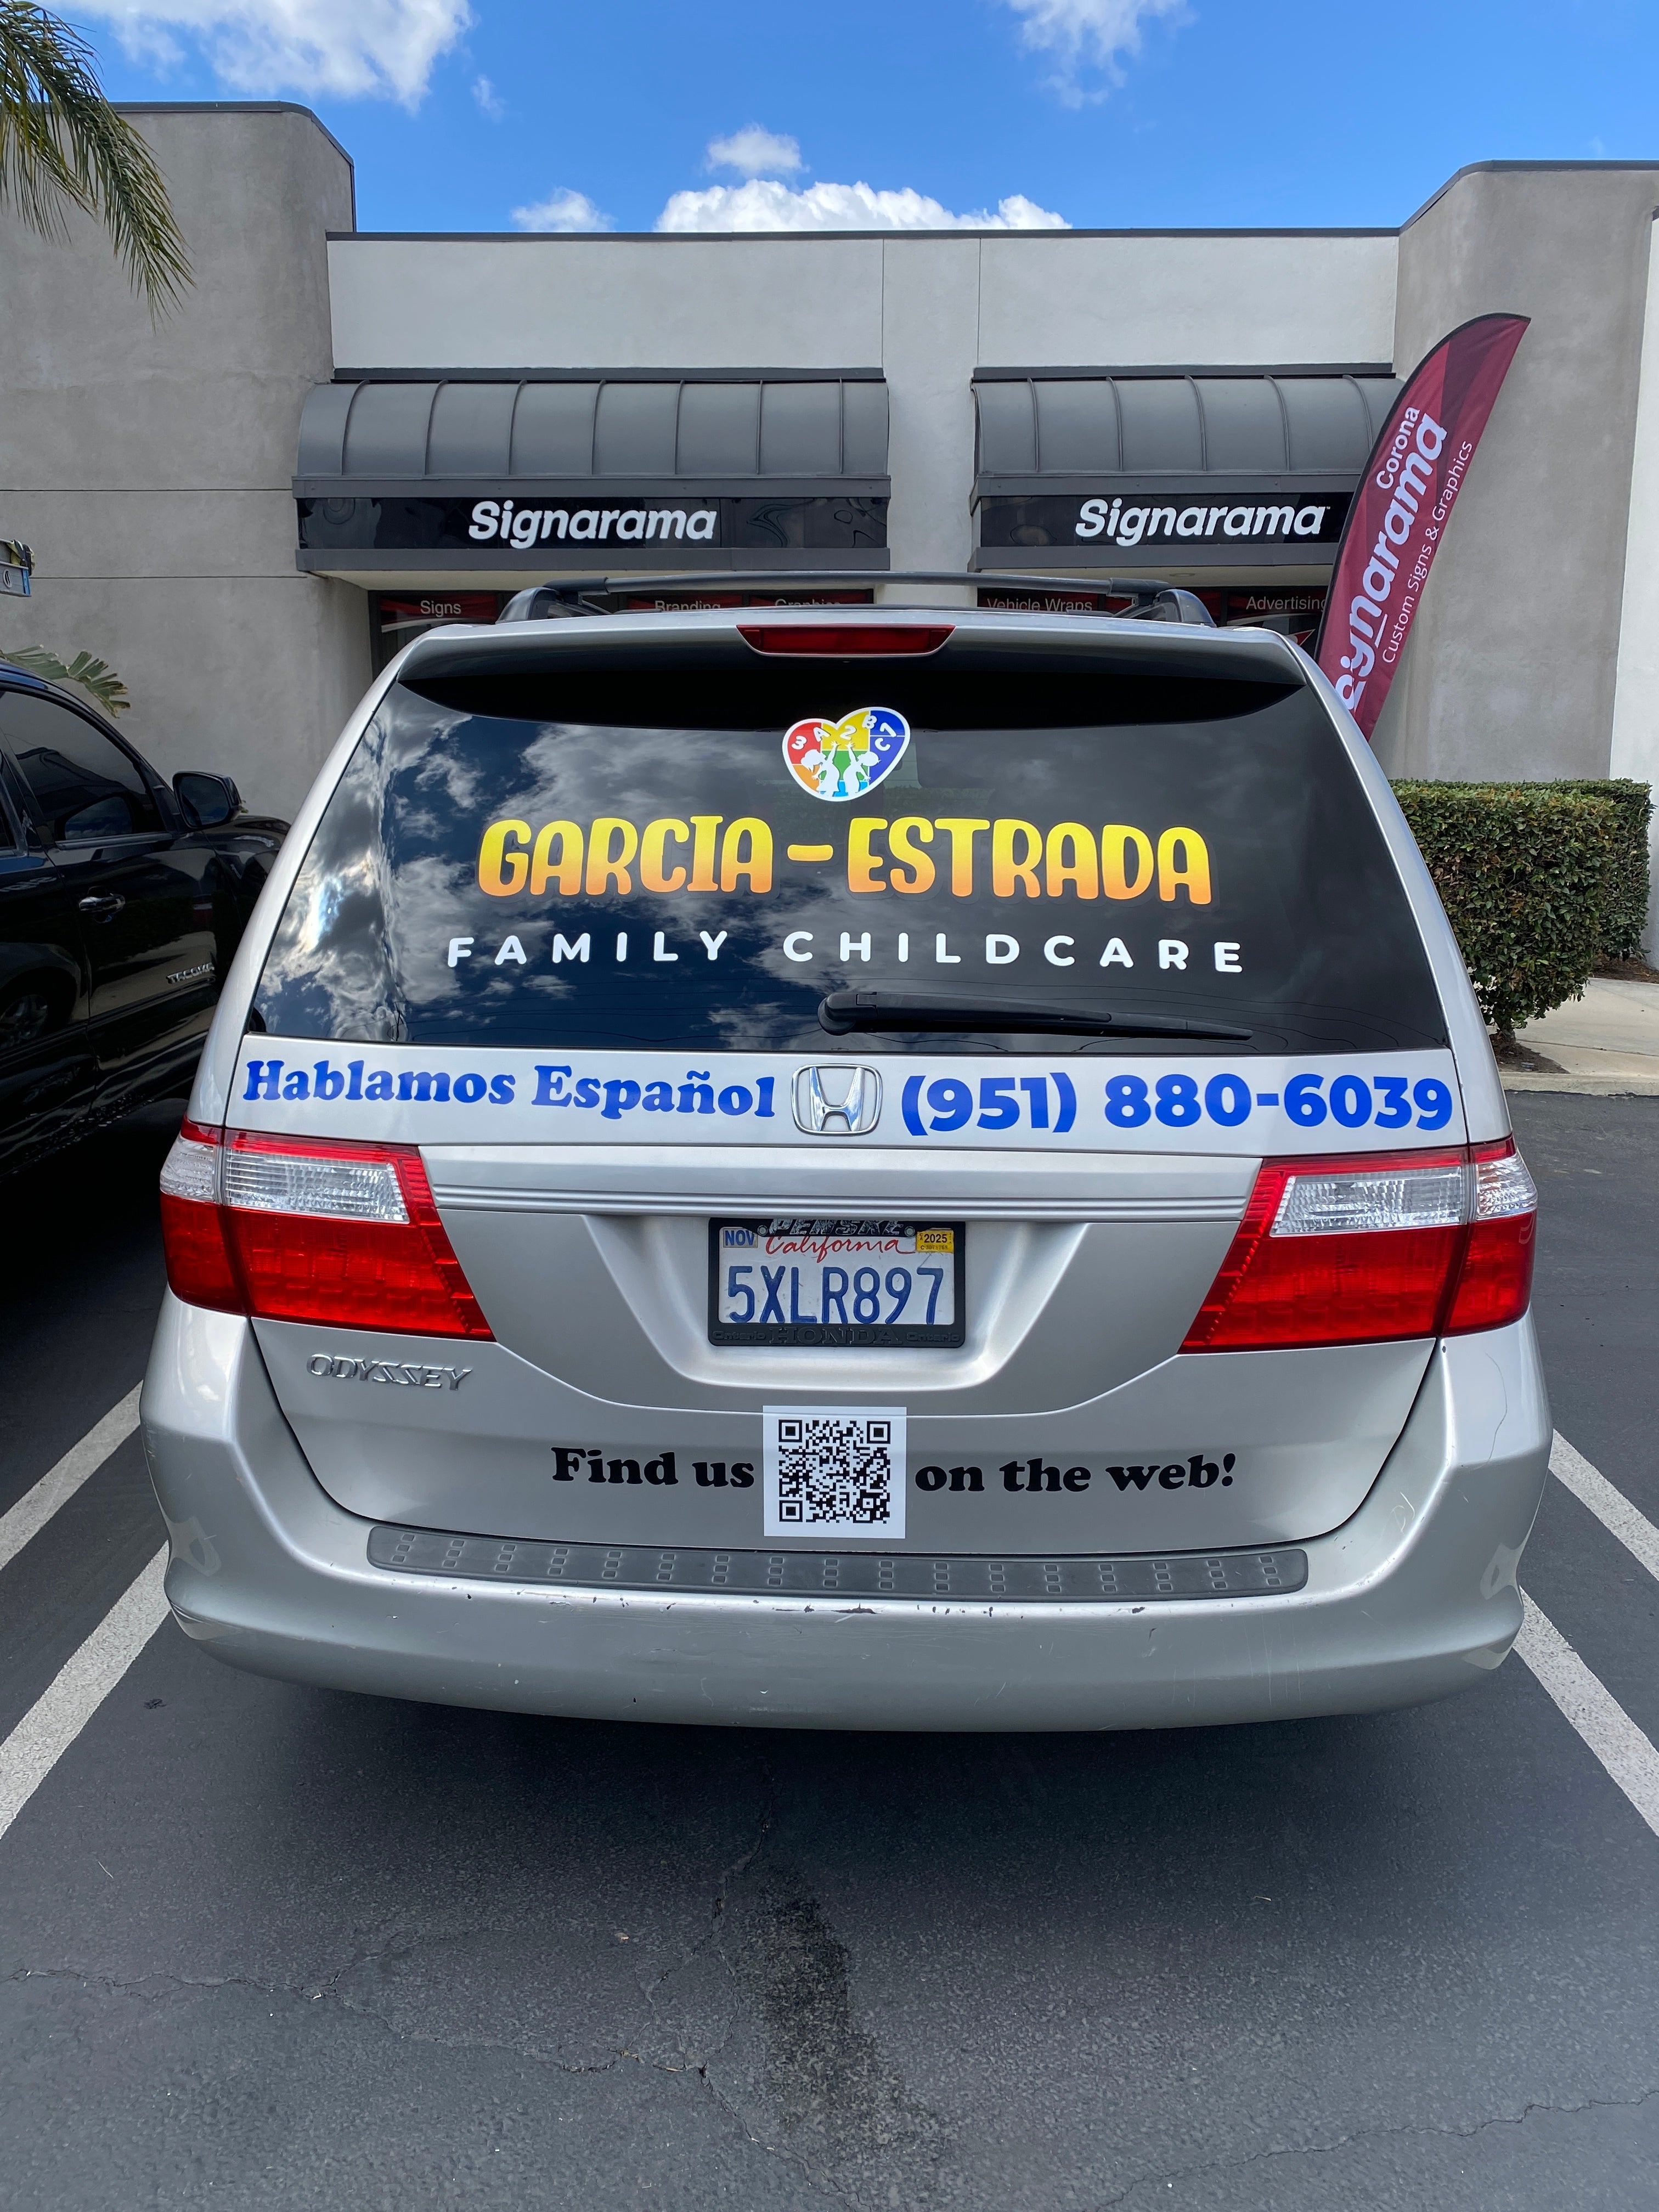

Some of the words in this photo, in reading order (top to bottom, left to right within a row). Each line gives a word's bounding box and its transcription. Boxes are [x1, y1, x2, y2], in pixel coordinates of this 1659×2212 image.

[1376, 407, 1420, 489] Corona
[1432, 441, 1473, 521] Graphics
[469, 499, 716, 549] Signarama
[1075, 498, 1325, 546] Signarama
[1425, 526, 1440, 540] &
[1408, 544, 1432, 592] Signs
[420, 600, 461, 617] Signs
[987, 598, 1041, 610] Vehicle
[1045, 598, 1092, 612] Wraps
[1382, 595, 1415, 663] Custom
[478, 816, 773, 896] GARCIA
[848, 817, 1212, 905] ESTRADA
[167, 962, 215, 984] TACOMA
[448, 931, 727, 968] FAMILY
[783, 931, 1243, 973] CHILDCARE
[242, 1060, 516, 1105] Hablamos
[531, 1064, 775, 1119] Español
[901, 1073, 1077, 1136] (951)
[1104, 1074, 1453, 1131] 880-6039
[725, 1230, 755, 1246] NOV
[769, 1218, 904, 1235] PENSKE
[924, 1233, 947, 1243] 2025
[765, 1236, 916, 1263] California
[727, 1266, 944, 1325] 5XLR897
[713, 1331, 766, 1340] Ontario
[769, 1326, 903, 1345] HONDA
[906, 1331, 962, 1342] Ontario
[306, 1353, 473, 1391] ODYSSEY
[550, 1447, 679, 1485] Find
[692, 1462, 754, 1488] us
[915, 1466, 985, 1492] on
[999, 1458, 1091, 1492] the
[1105, 1453, 1236, 1491] web!
